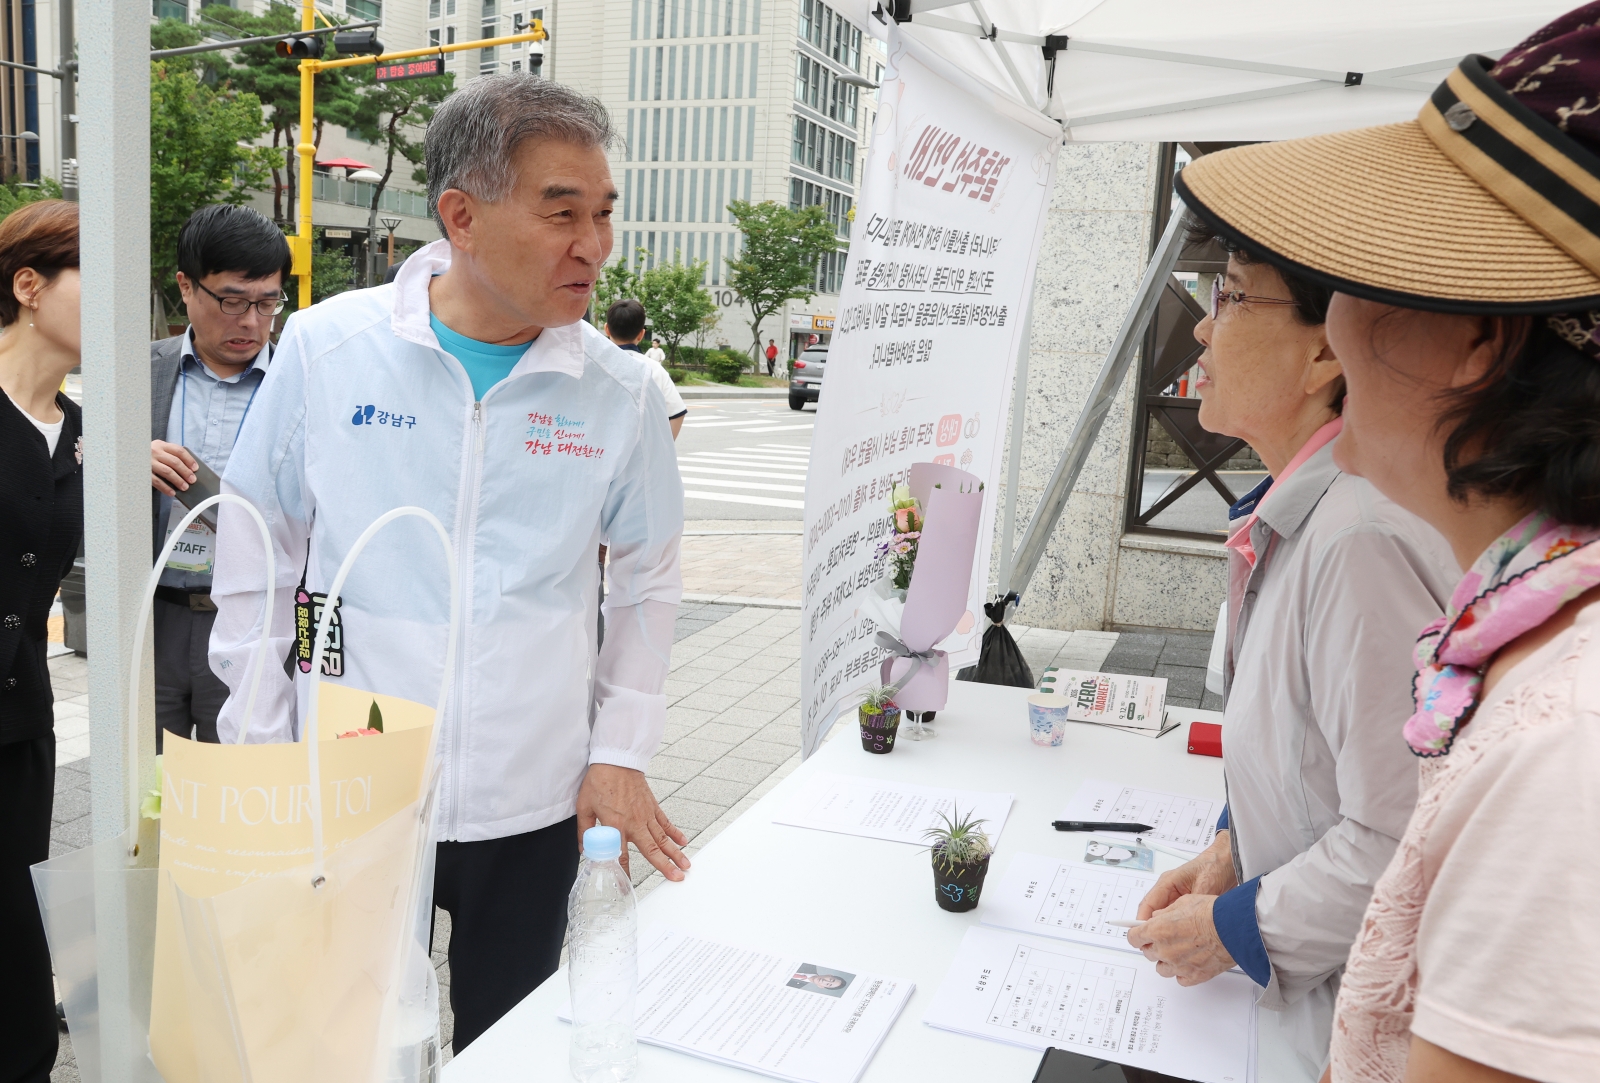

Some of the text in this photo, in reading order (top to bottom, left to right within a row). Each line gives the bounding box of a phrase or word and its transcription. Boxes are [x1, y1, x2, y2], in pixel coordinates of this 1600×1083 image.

[714, 290, 745, 307] 104
[377, 410, 417, 429] 강남구
[528, 412, 585, 428] 강남을 힘차게!
[526, 426, 585, 440] 구민을 신나게!
[525, 440, 604, 459] 강남 대전환!!
[298, 606, 310, 658] 강남구청장
[1077, 682, 1098, 708] ZERO
[1095, 682, 1109, 710] MARKET
[163, 772, 372, 826] NT POUR TOI
[974, 968, 992, 992] 신상카드
